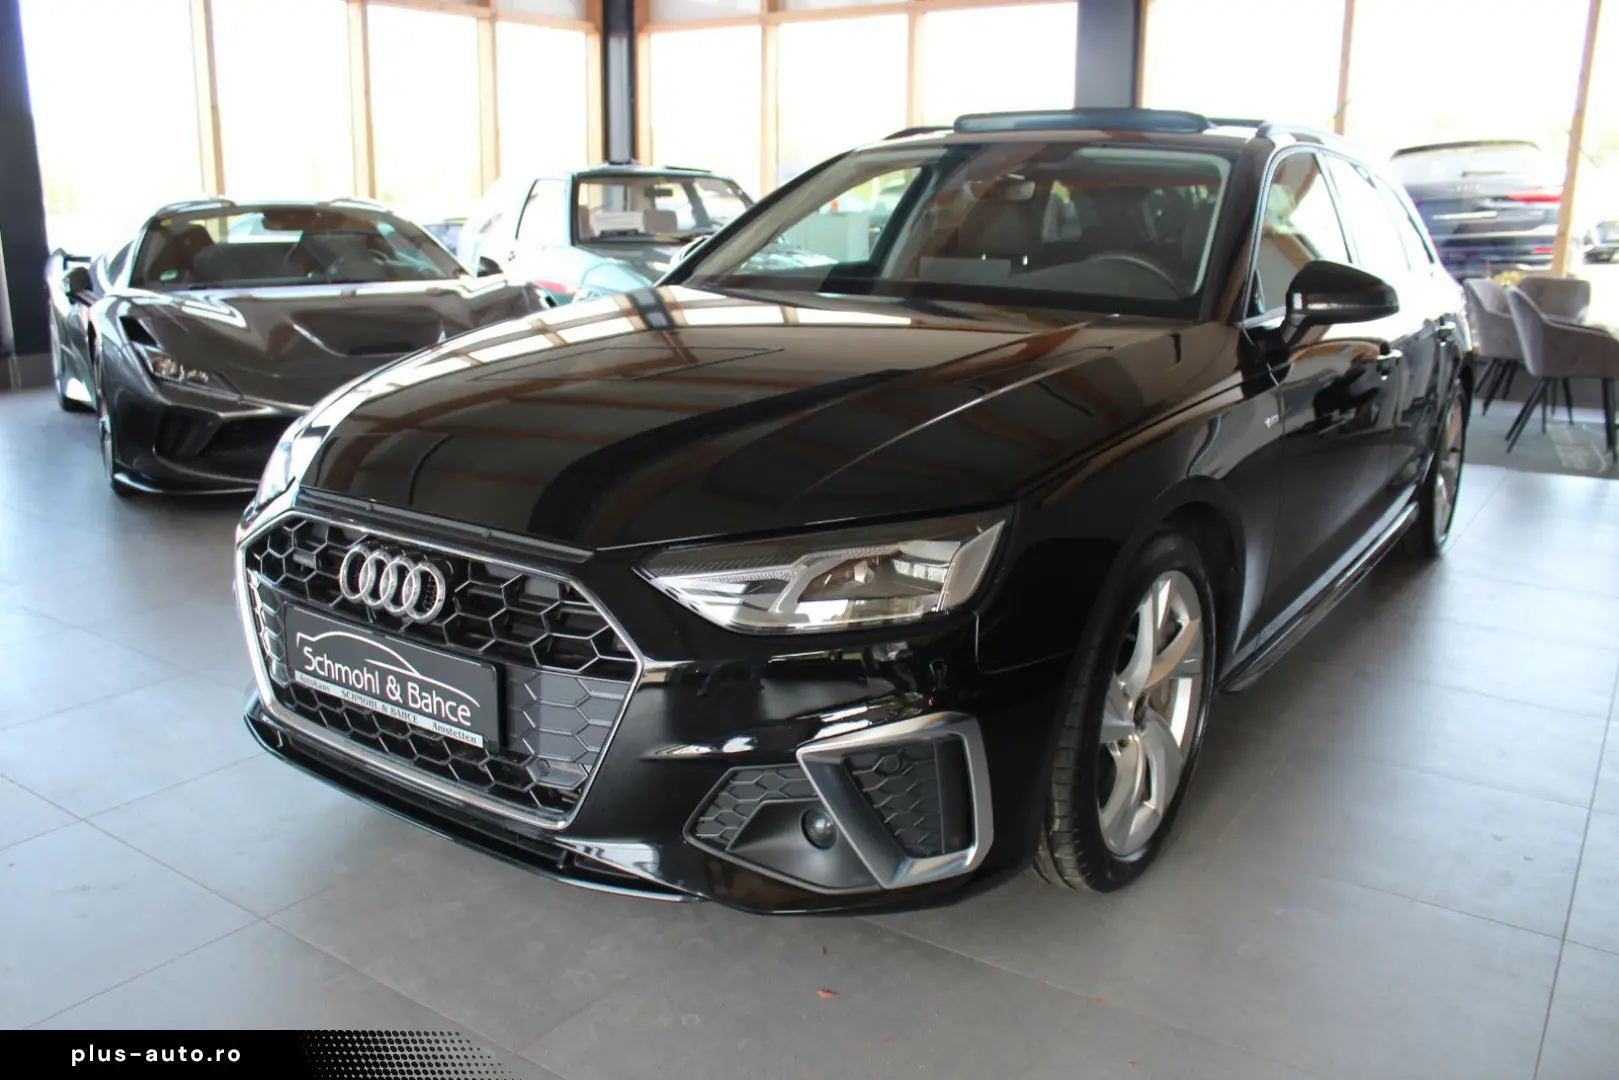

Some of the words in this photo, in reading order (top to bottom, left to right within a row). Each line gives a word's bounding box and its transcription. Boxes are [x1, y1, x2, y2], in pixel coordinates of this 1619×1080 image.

[303, 646, 380, 695] Schmohl
[386, 674, 402, 704] &
[407, 681, 471, 727] Bahce
[341, 689, 378, 709] SCHMOHL
[381, 703, 388, 713] &
[391, 708, 418, 723] BAHCE
[432, 721, 477, 744] Amstetten
